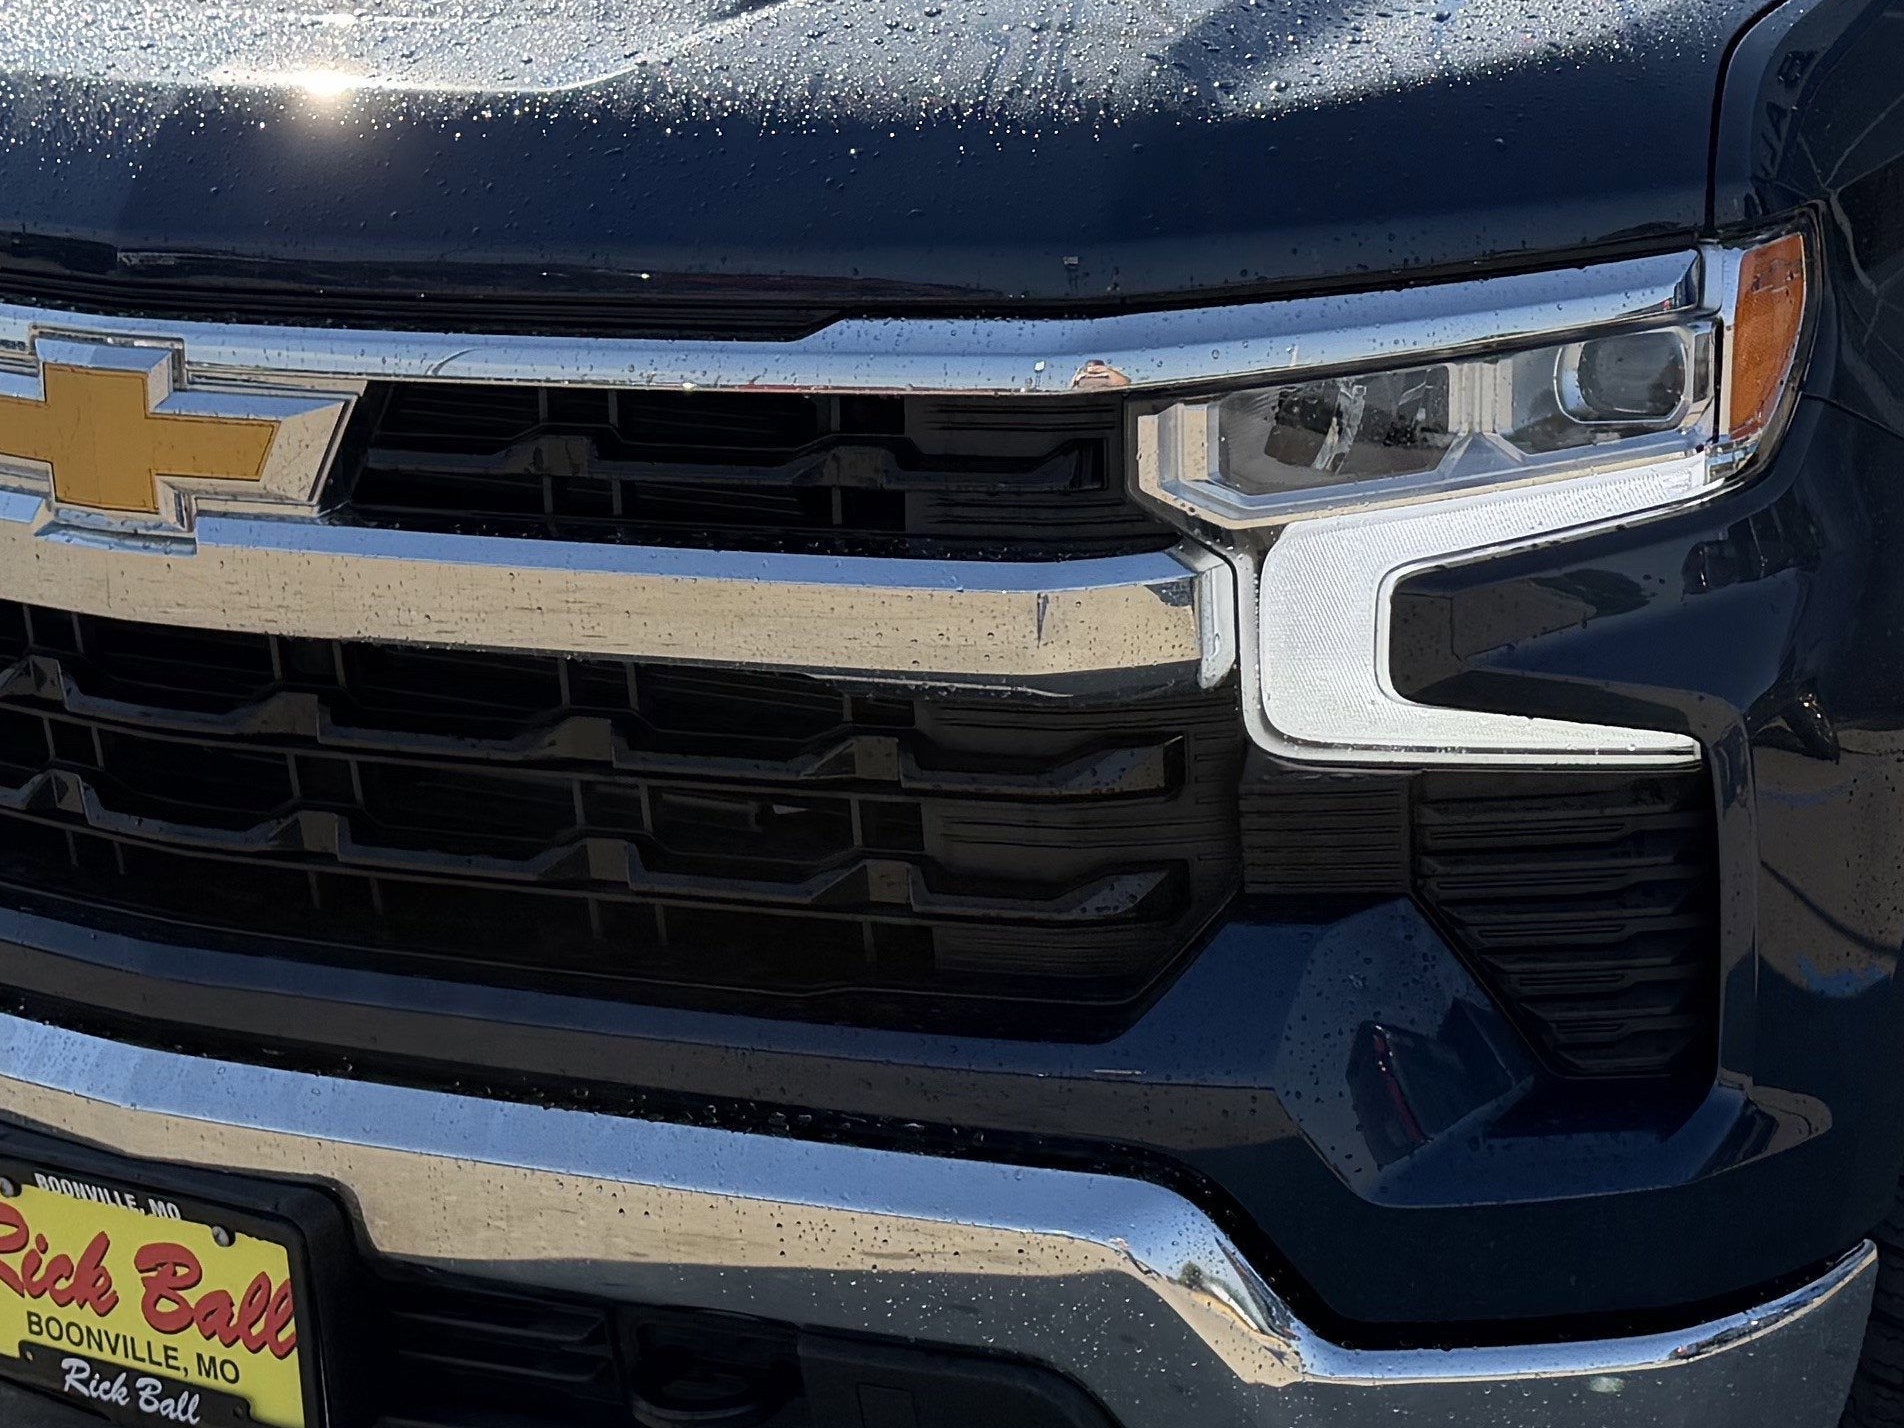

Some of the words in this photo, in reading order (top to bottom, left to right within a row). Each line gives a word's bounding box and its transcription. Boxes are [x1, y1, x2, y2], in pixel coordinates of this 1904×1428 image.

[33, 1172, 146, 1216] BOONVILLE,
[148, 1198, 181, 1220] MO
[134, 1241, 297, 1360] Ball
[26, 1310, 190, 1378] BOONVILLE,
[196, 1353, 240, 1385] MO
[60, 1357, 130, 1406] Rick
[135, 1377, 201, 1425] Ball
